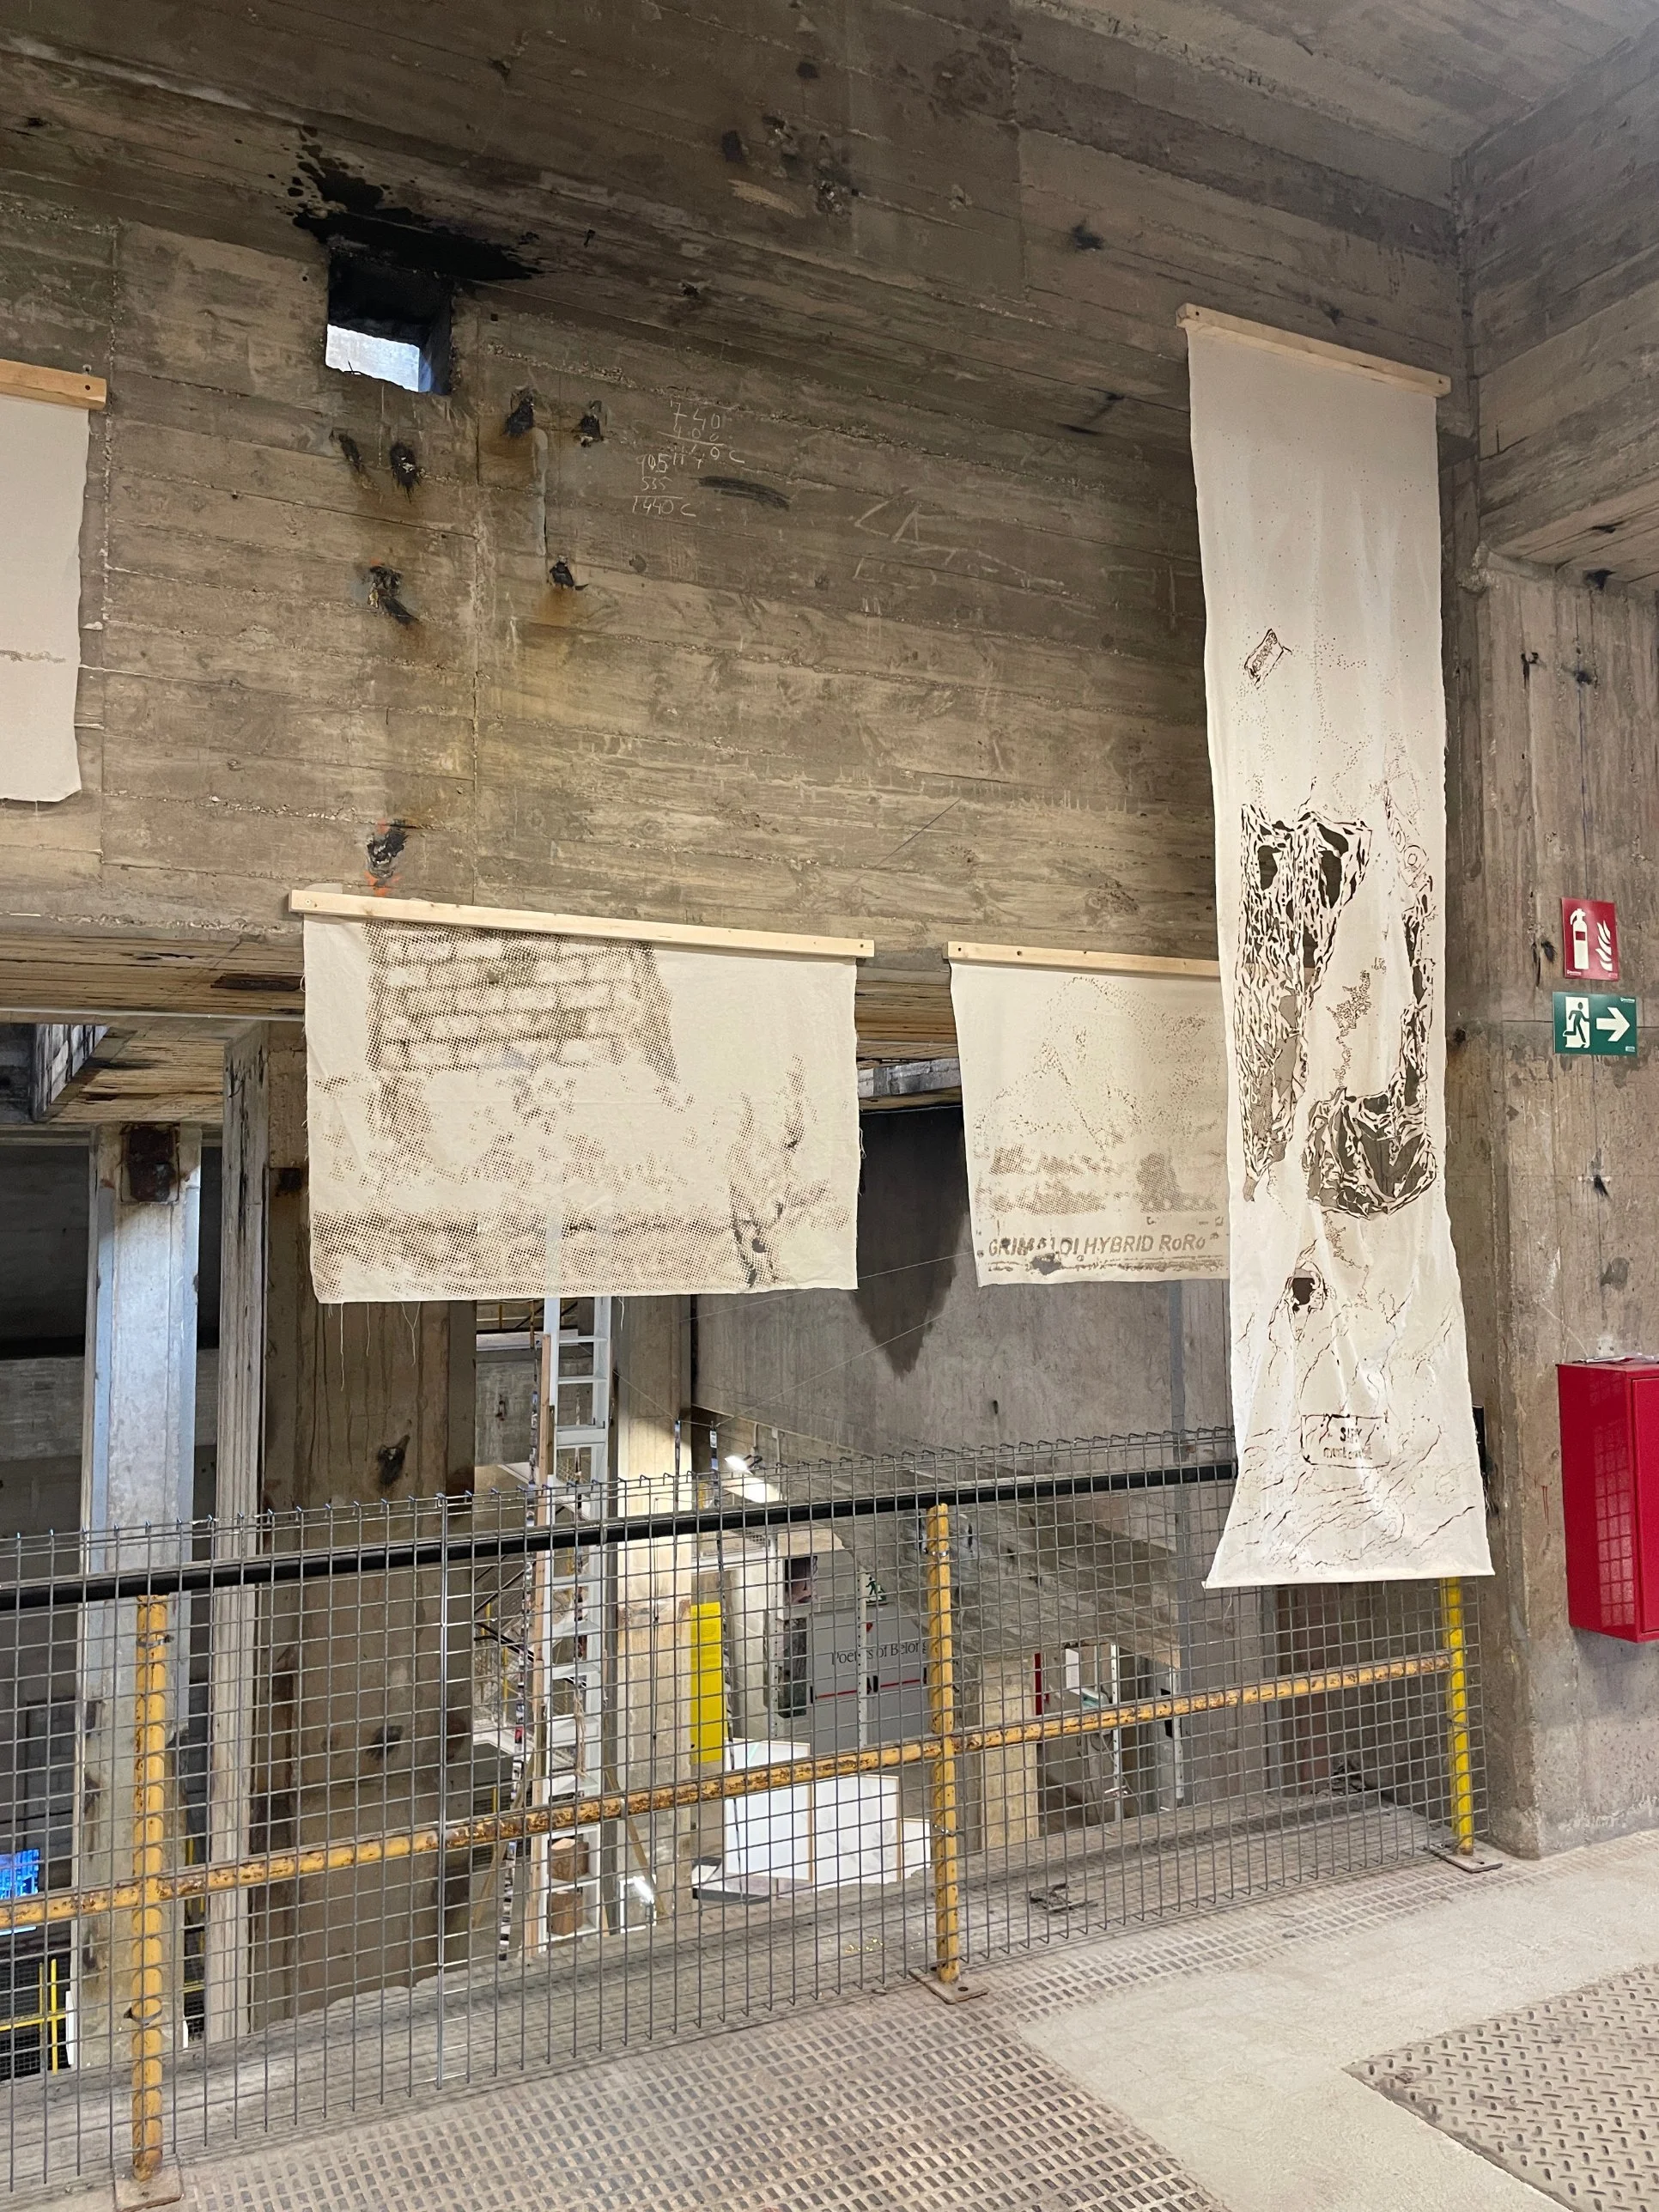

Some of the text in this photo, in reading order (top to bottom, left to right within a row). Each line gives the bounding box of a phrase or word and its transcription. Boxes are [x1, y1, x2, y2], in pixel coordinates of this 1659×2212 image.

[670, 400, 721, 430] 740
[632, 496, 674, 516] 1440
[1084, 1235, 1154, 1255] HYBRID
